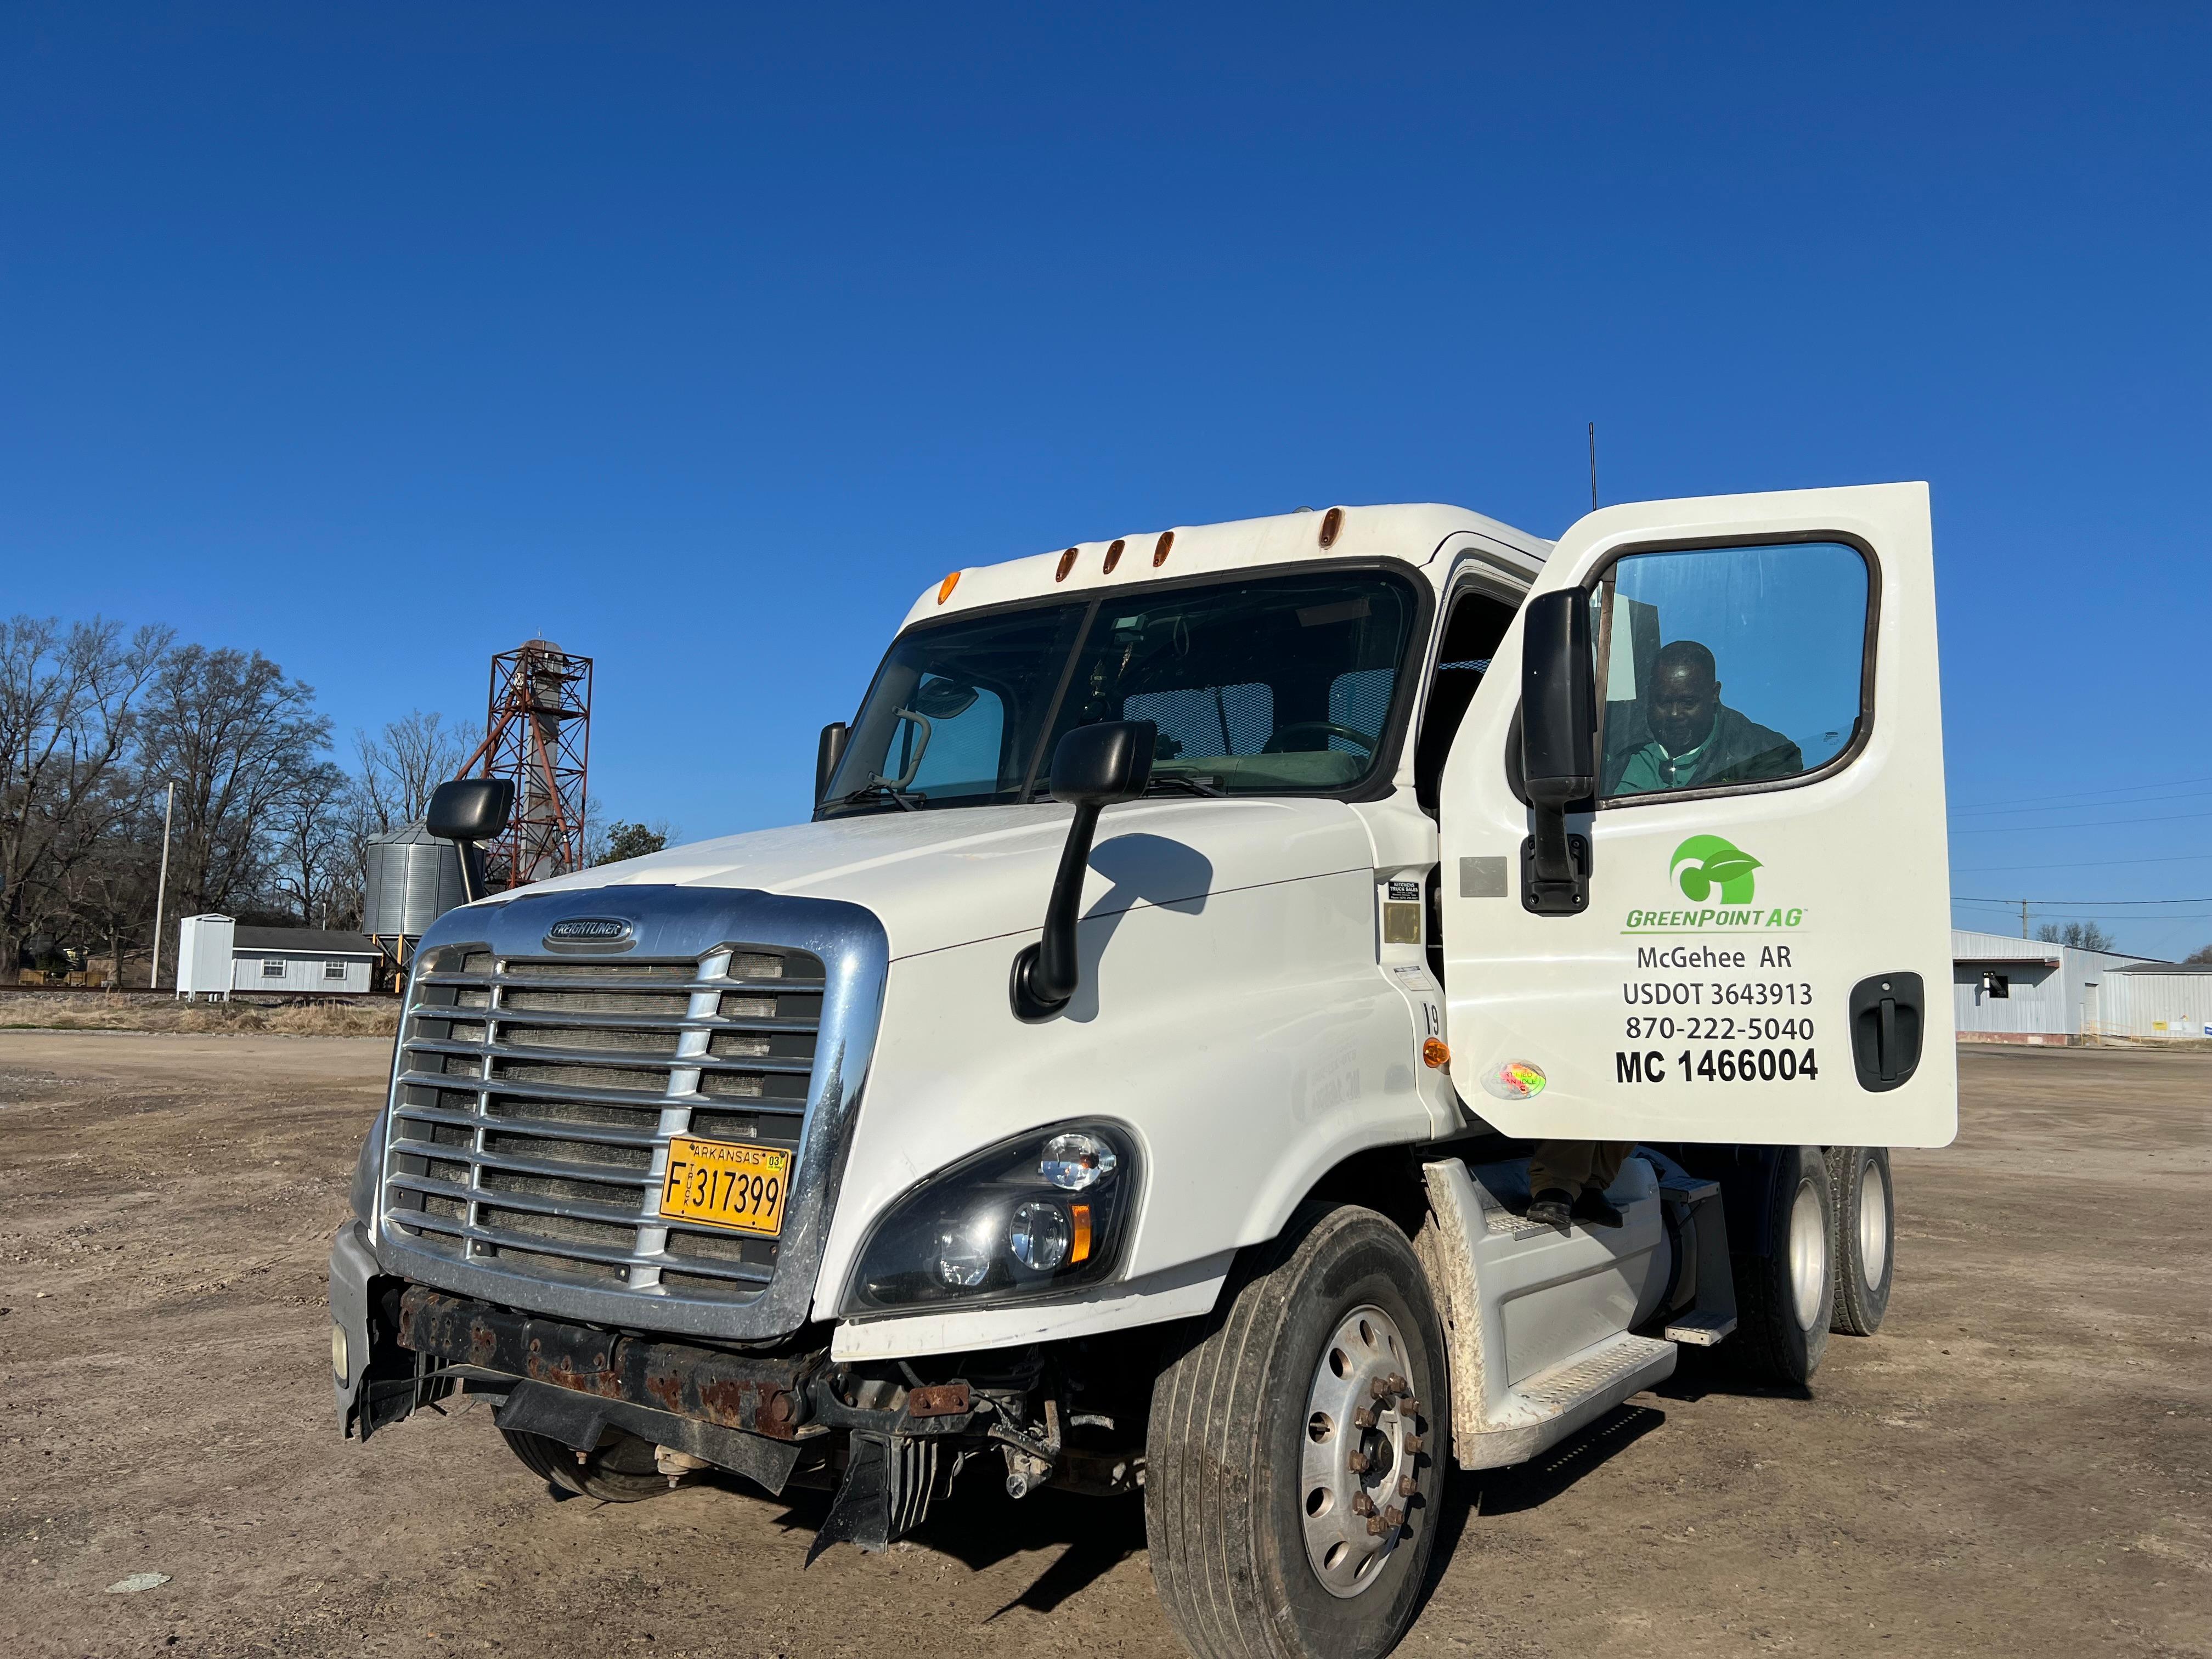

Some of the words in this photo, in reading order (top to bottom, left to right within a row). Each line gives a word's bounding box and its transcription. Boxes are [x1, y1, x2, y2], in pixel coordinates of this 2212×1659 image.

[553, 922, 619, 934] FREIGHTLINER
[1638, 945, 1746, 968] McGehee
[1760, 945, 1792, 968] AR
[1623, 983, 1704, 1005] USDOT
[1711, 983, 1813, 1005] 3643913
[1626, 1017, 1814, 1040] 870-222-5040
[1616, 1050, 1666, 1084] MC
[1678, 1048, 1818, 1082] 1466004
[693, 1145, 760, 1165] ARKANSAS
[769, 1156, 779, 1166] 03
